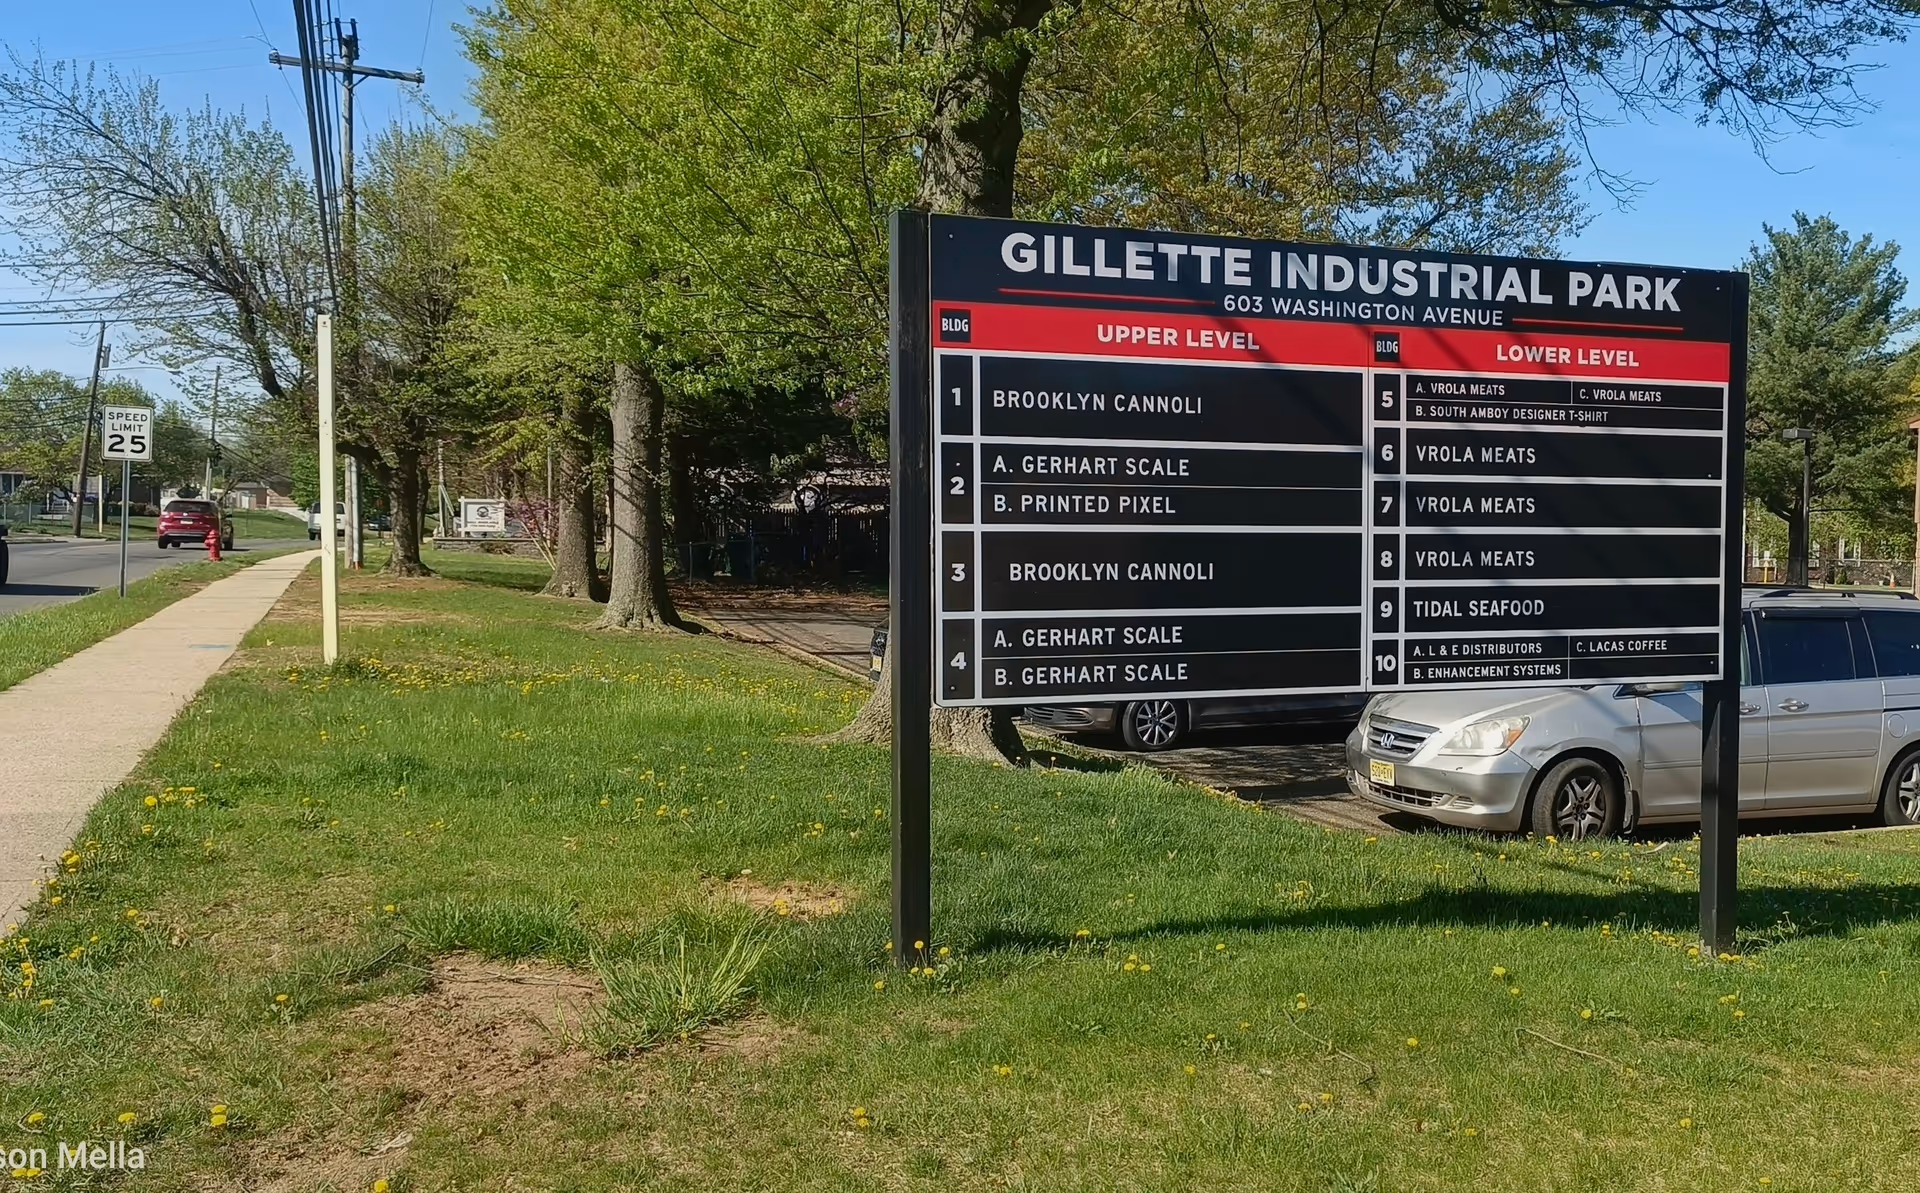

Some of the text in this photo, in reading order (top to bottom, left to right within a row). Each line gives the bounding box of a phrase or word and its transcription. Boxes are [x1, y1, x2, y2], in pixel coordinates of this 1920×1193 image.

[1000, 231, 1683, 313] GILLETTE INDUSTRIAL PARK
[1223, 294, 1503, 326] 603 WASHINGTON AVENUE
[941, 317, 969, 333] BLDG
[1097, 324, 1260, 350] UPPER LEVEL
[1376, 340, 1399, 354] BLDG
[1496, 344, 1640, 367] LOWER LEVEL
[951, 387, 961, 406] 1
[1415, 382, 1505, 396] A. VROLA MEATS
[1579, 388, 1662, 402] C. VROLA MEATS
[993, 389, 1202, 414] BROOKLYN CANNOLI
[1381, 390, 1394, 408] 5
[108, 412, 148, 422] SPEED
[1415, 405, 1609, 422] B. SOUTH AMBOY DESIGNER T-SHIRT
[111, 423, 143, 432] LIMIT
[108, 434, 146, 454] 25
[1381, 444, 1394, 462] 6
[1415, 444, 1536, 464] VROLA MEATS
[992, 454, 1190, 476] A. GERHART SCALE
[950, 476, 965, 495] 2
[994, 494, 1176, 514] B. PRINTED PIXEL
[1380, 496, 1393, 514] 7
[1416, 496, 1536, 514] VROLA MEATS
[1380, 550, 1393, 568] 8
[1415, 550, 1535, 567] VROLA MEATS
[951, 563, 966, 582] 3
[1009, 562, 1214, 582] BROOKLYN CANNOLI
[1380, 600, 1393, 618] 9
[1413, 599, 1545, 618] TIDAL SEAFOOD
[993, 625, 1183, 648] A. GERHART SCALE
[1576, 639, 1668, 653] C. LACAS COFFEE
[1413, 642, 1543, 657] A. L & E DISTRIBUTORS
[950, 651, 967, 670] 4
[1374, 654, 1397, 673] 10
[994, 663, 1188, 686] B. GERHART SCALE
[1413, 663, 1562, 679] B. ENHANCEMENT SYSTEMS
